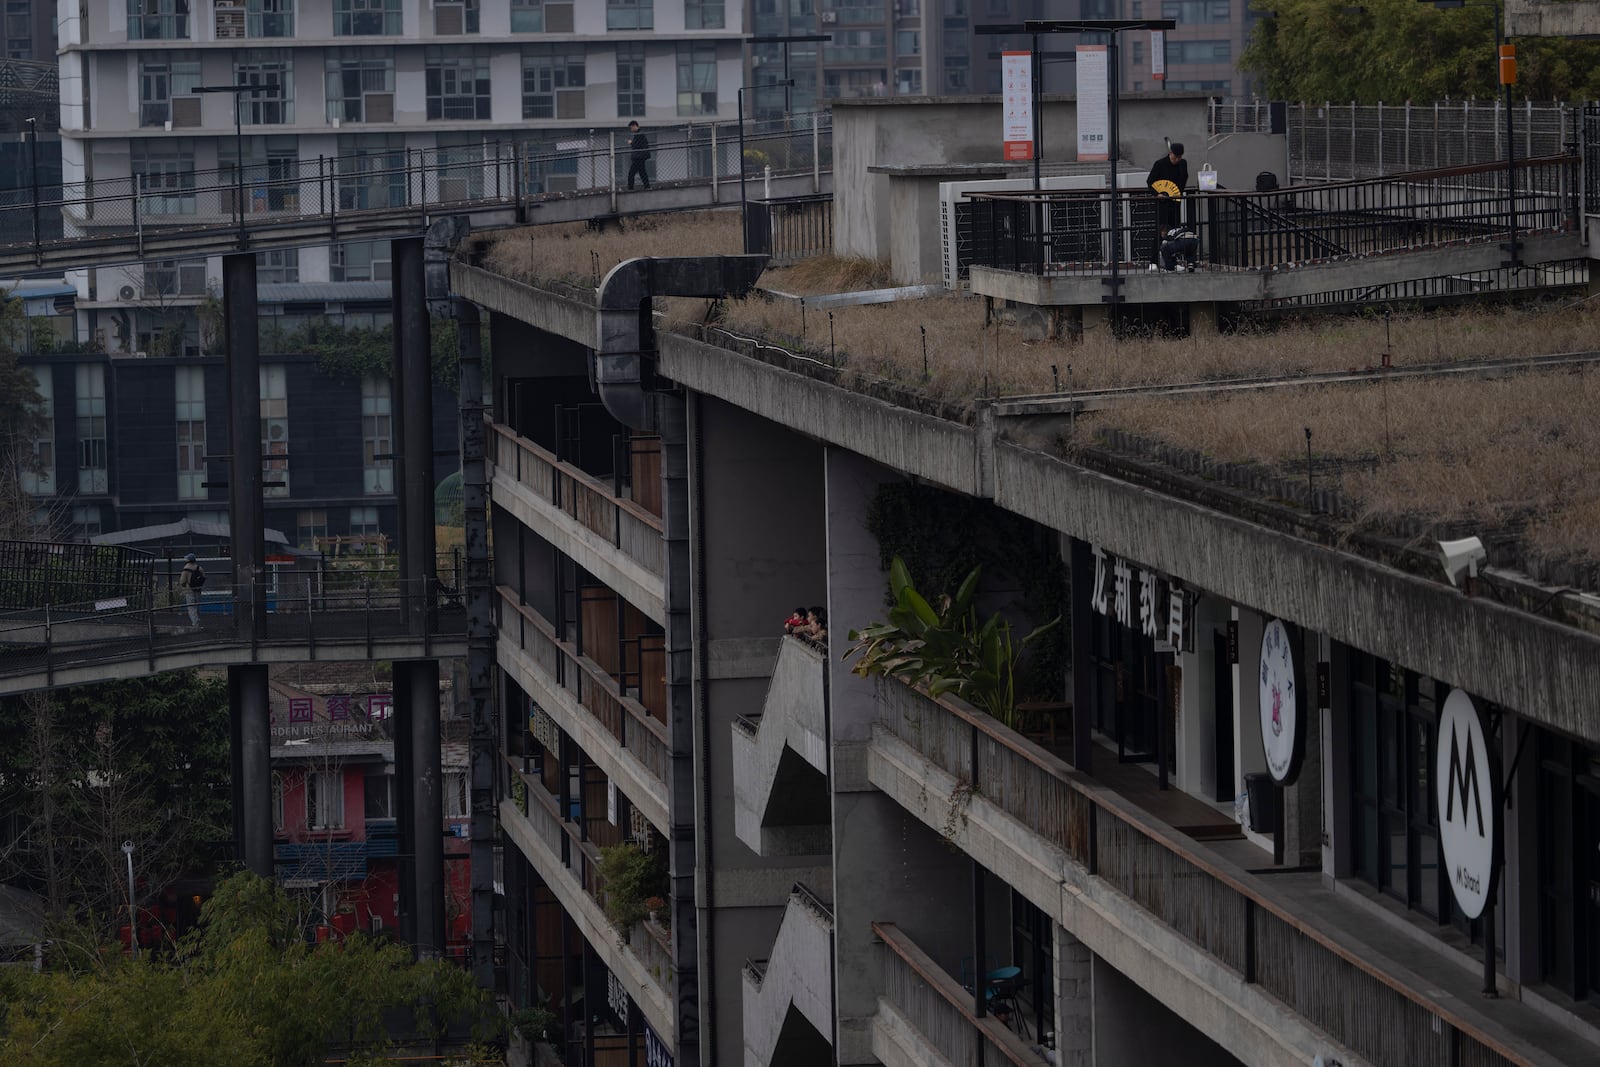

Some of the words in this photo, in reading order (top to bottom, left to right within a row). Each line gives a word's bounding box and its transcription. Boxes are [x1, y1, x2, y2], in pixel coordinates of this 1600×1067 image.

[303, 724, 374, 737] RESTAURANT
[1446, 718, 1485, 838] M
[1456, 865, 1464, 887] M
[1463, 868, 1481, 895] Stand
